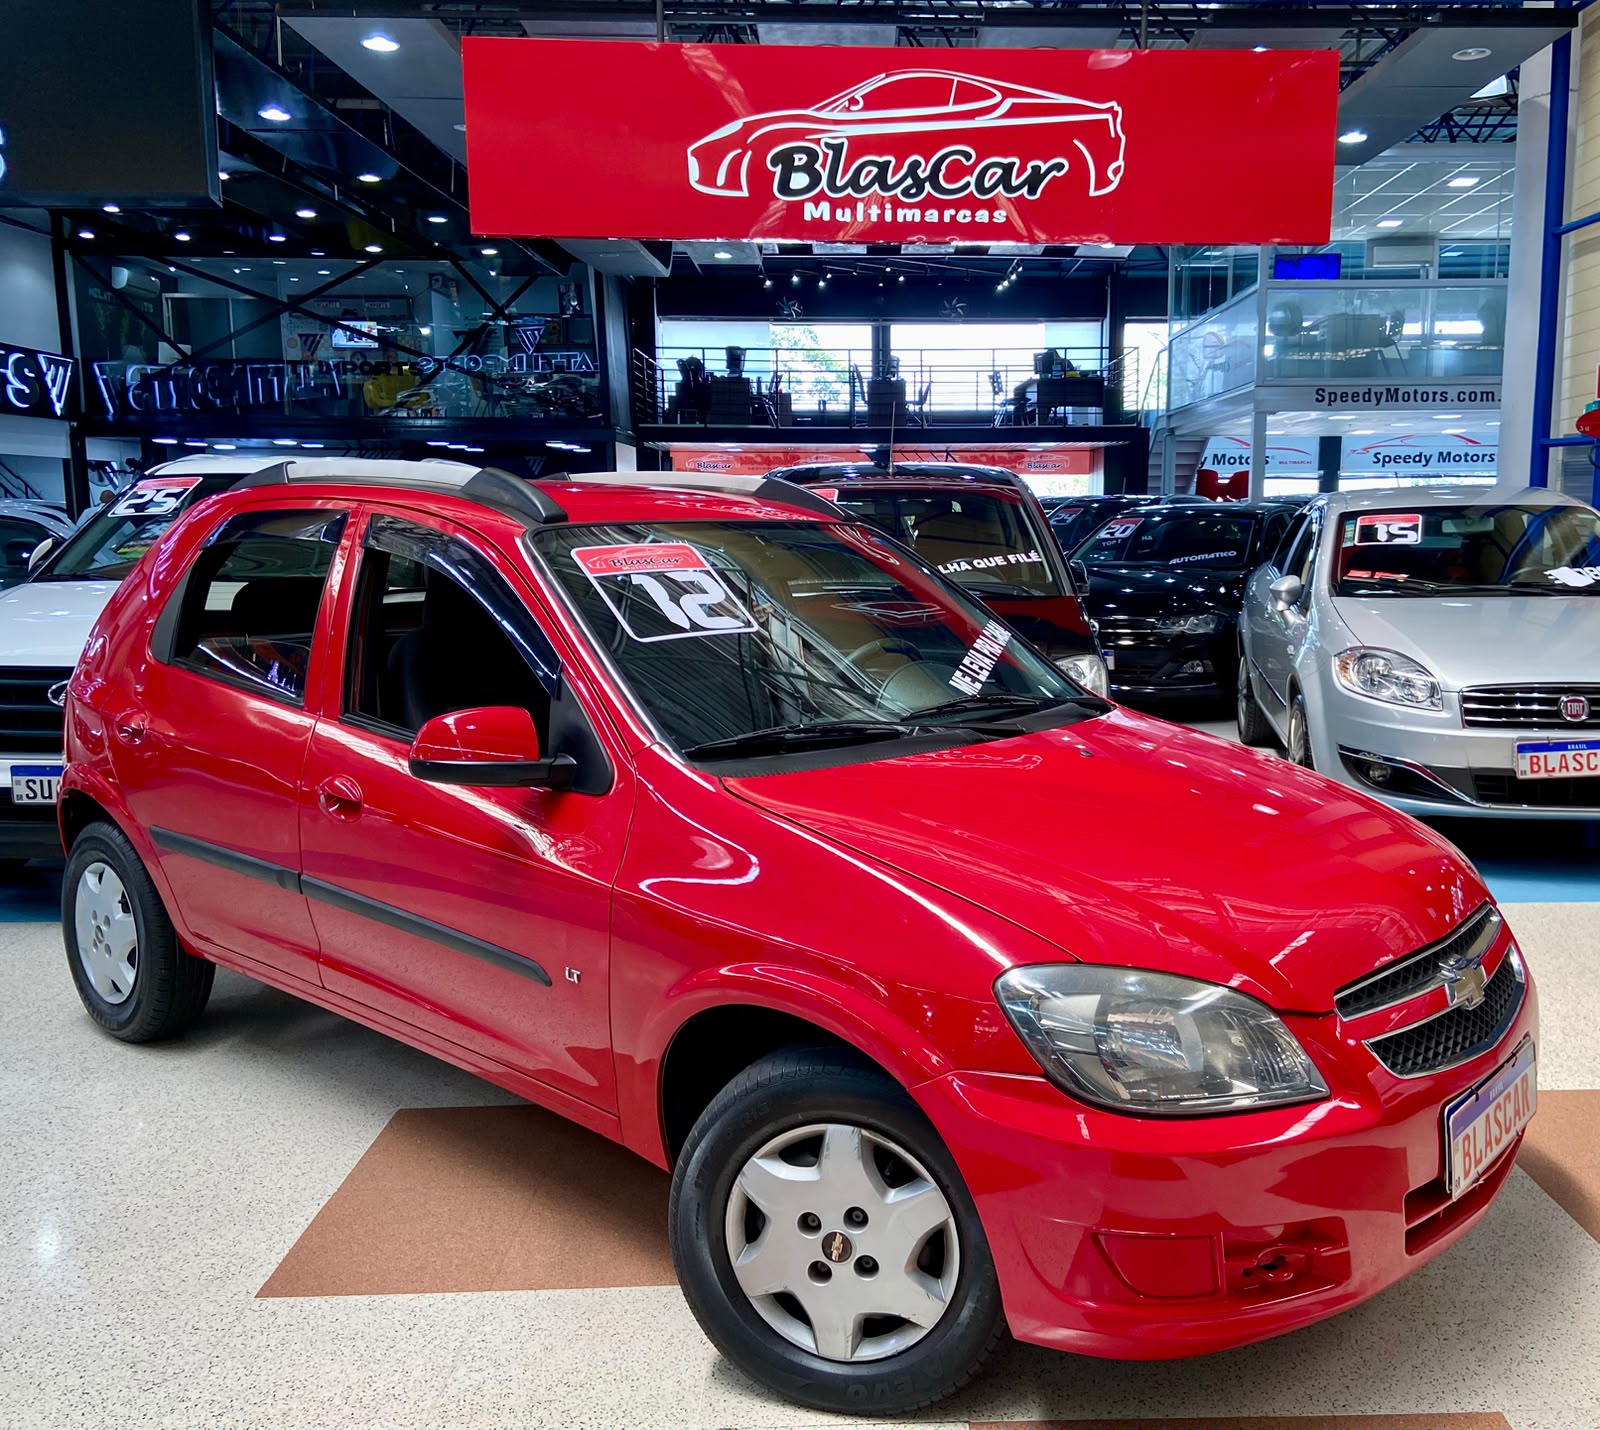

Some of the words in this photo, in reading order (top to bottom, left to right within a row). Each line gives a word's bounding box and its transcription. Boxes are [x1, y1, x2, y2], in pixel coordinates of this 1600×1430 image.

[766, 138, 1069, 202] BlasCar
[804, 202, 1008, 223] Multimarcas
[1372, 451, 1433, 468] Speedy
[1437, 450, 1496, 464] Motors
[114, 488, 184, 514] 25
[1101, 524, 1136, 538] 20
[1374, 523, 1418, 542] 15
[609, 556, 683, 567] BlasCar
[921, 561, 972, 574] LHA
[972, 555, 1007, 568] QUE
[1007, 549, 1042, 564] FILÉ
[1168, 550, 1238, 565] AUTOMATICO
[630, 571, 747, 631] 12
[972, 634, 1004, 662] PRA
[959, 649, 996, 682] LEVA
[948, 670, 983, 698] ME
[1567, 702, 1584, 714] FIAT
[1529, 752, 1598, 774] BLASC
[25, 779, 60, 800] SU
[565, 966, 581, 984] LT
[1462, 1072, 1530, 1181] BLASCAR
